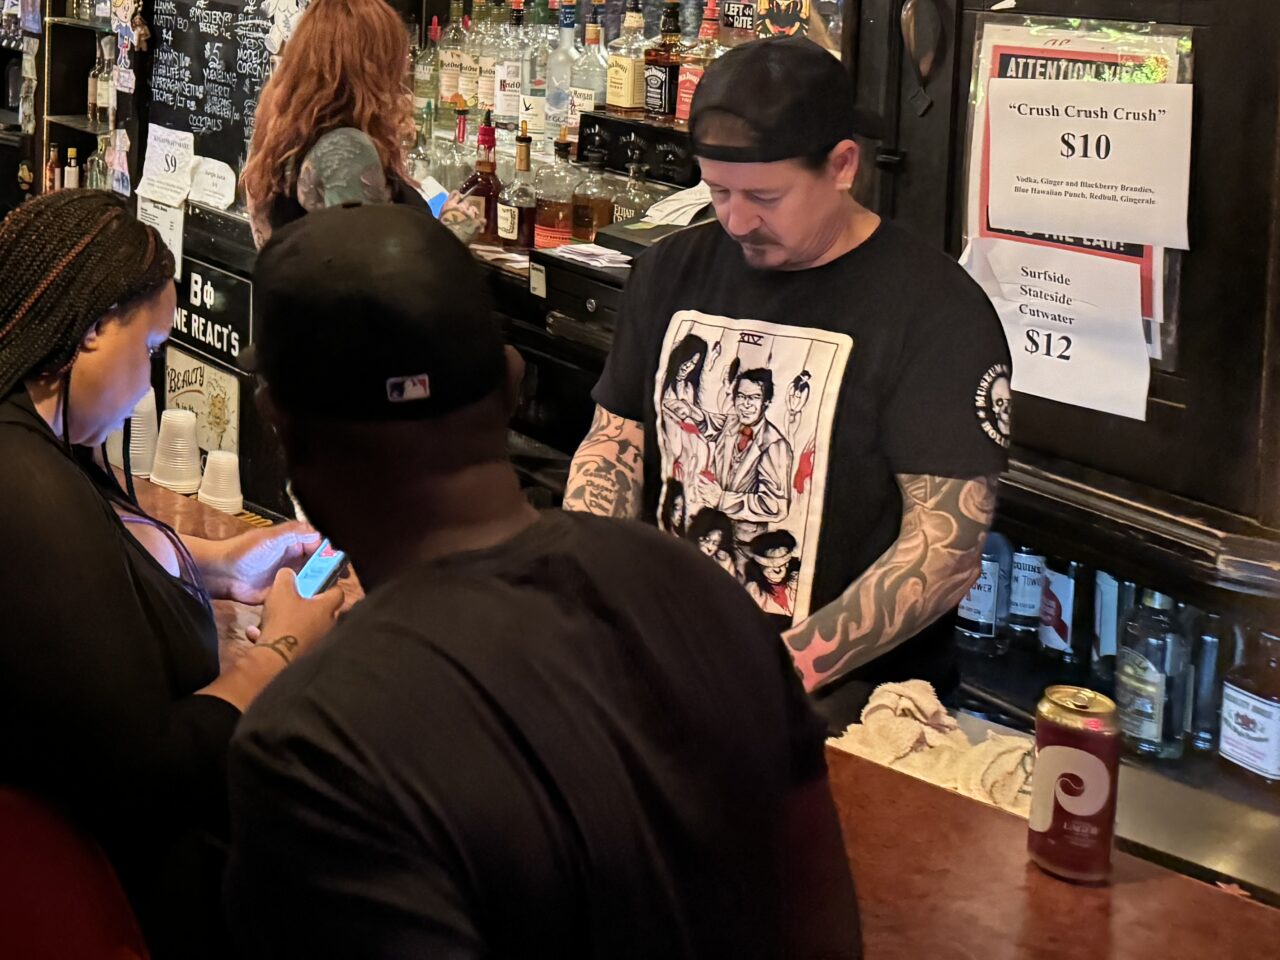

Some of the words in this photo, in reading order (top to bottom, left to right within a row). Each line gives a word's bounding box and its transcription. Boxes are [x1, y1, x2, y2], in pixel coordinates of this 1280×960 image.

[724, 1, 744, 16] LEFT
[153, 13, 176, 31] NATTY
[177, 17, 189, 32] BO
[733, 16, 753, 29] RITE
[236, 48, 270, 64] MODELO
[236, 60, 271, 79] CORONA
[1064, 104, 1108, 120] Crush
[1060, 132, 1112, 160] $10
[163, 153, 178, 174] $9
[1016, 175, 1040, 185] Vodka,
[1040, 177, 1064, 188] Ginger
[1065, 179, 1079, 188] and
[1080, 180, 1119, 192] Blackberry
[1014, 186, 1029, 194] Blue
[1030, 187, 1063, 198] Hawaiian
[1064, 190, 1088, 200] Punch,
[1120, 195, 1157, 206] Gingerale
[1020, 265, 1071, 286] Surfside
[1019, 284, 1073, 306] Stateside
[1018, 303, 1075, 325] Cutwater
[191, 312, 240, 358] REACT'S
[1024, 328, 1073, 361] $12
